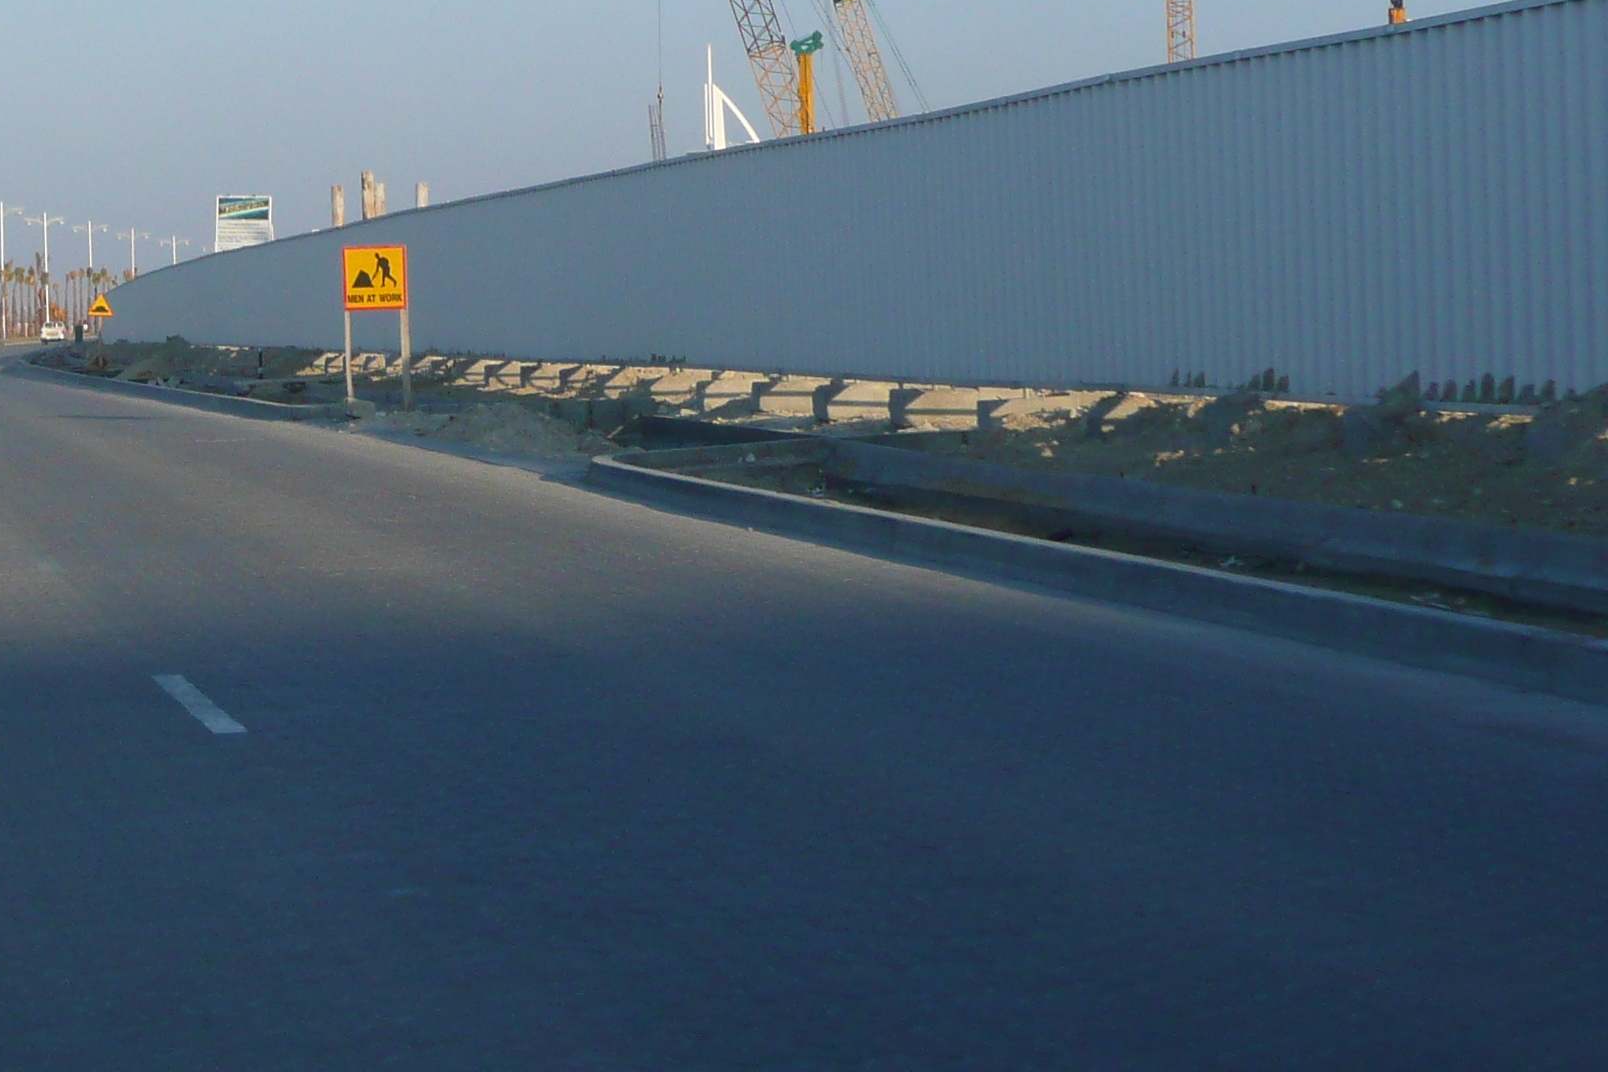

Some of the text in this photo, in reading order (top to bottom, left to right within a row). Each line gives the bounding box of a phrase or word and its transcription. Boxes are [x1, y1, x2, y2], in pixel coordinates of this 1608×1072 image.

[347, 293, 403, 303] MEN AT WORK
